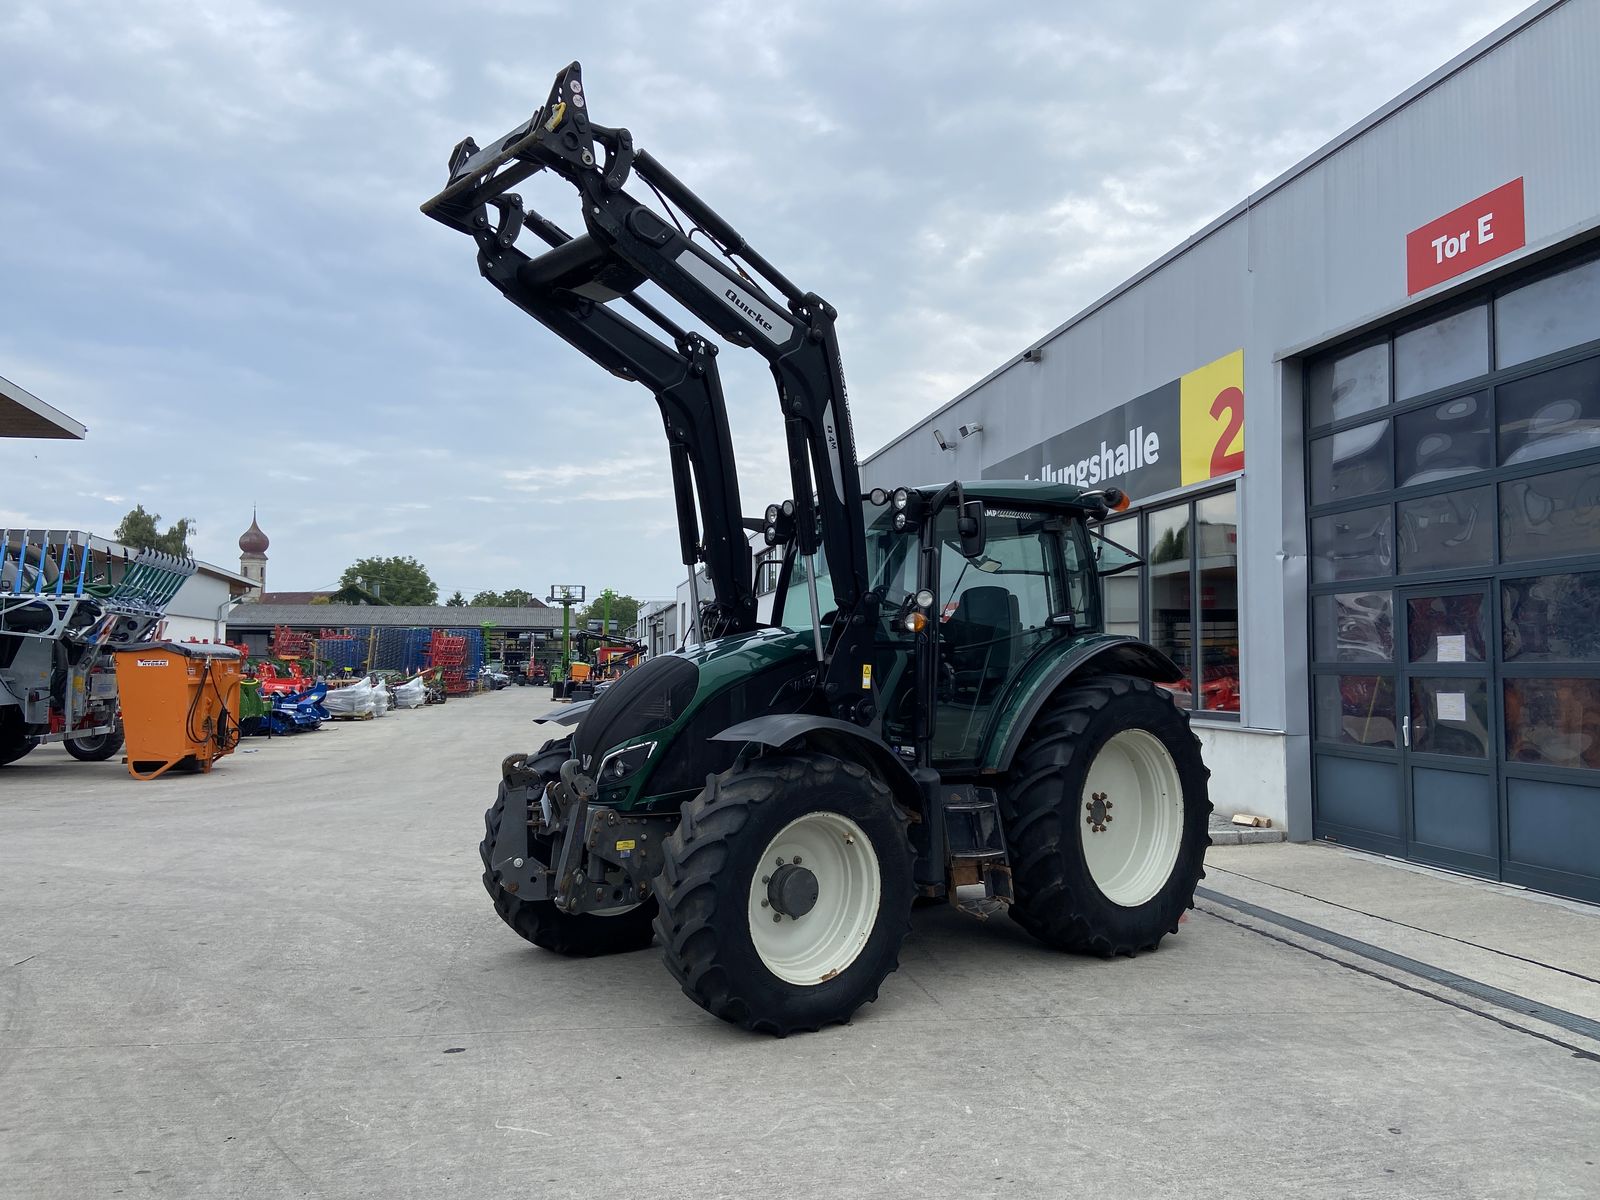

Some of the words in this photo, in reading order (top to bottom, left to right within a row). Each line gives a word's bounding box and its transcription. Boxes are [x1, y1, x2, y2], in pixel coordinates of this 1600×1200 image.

[1431, 230, 1470, 264] Tor
[1477, 212, 1494, 245] E
[725, 289, 774, 331] Quicke
[1024, 425, 1160, 488] llungshalle
[1209, 386, 1245, 479] 2
